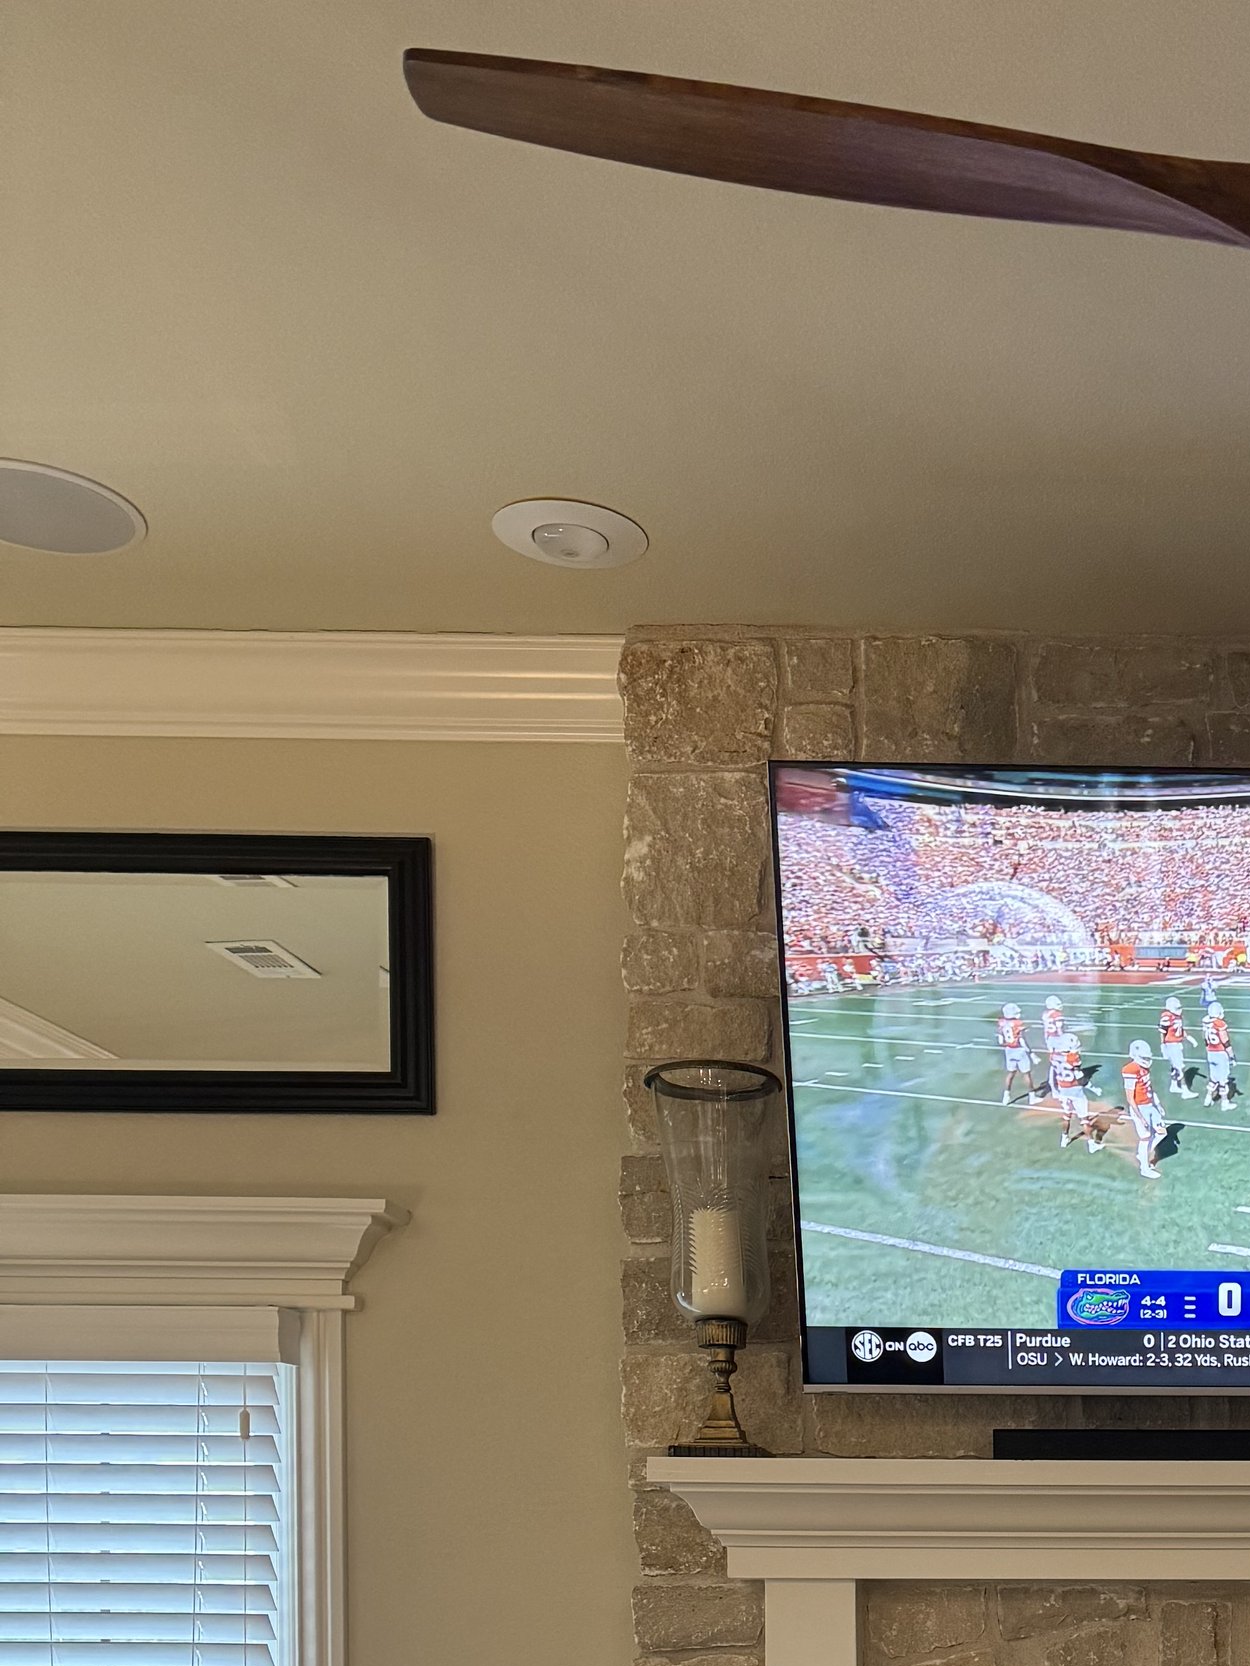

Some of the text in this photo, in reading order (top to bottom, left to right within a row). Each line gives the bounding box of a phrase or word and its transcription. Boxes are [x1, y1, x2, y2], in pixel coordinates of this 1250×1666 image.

[1077, 1274, 1141, 1285] FLORIDA
[1141, 1296, 1166, 1307] 4-4
[1218, 1282, 1242, 1317] 0
[1140, 1309, 1167, 1319] (2-3)
[854, 1333, 935, 1360] SEC ON abc
[948, 1335, 1002, 1347] CFB T25
[1015, 1333, 1155, 1348] Purdue 0
[1167, 1336, 1177, 1348] 2
[1179, 1335, 1215, 1348] Ohio
[1016, 1352, 1047, 1366] OSU
[1069, 1353, 1085, 1366] W.
[1088, 1353, 1143, 1366] Howard:
[1146, 1353, 1172, 1368] 2-3,
[1174, 1354, 1192, 1367] 32
[1195, 1354, 1221, 1368] Yds,
